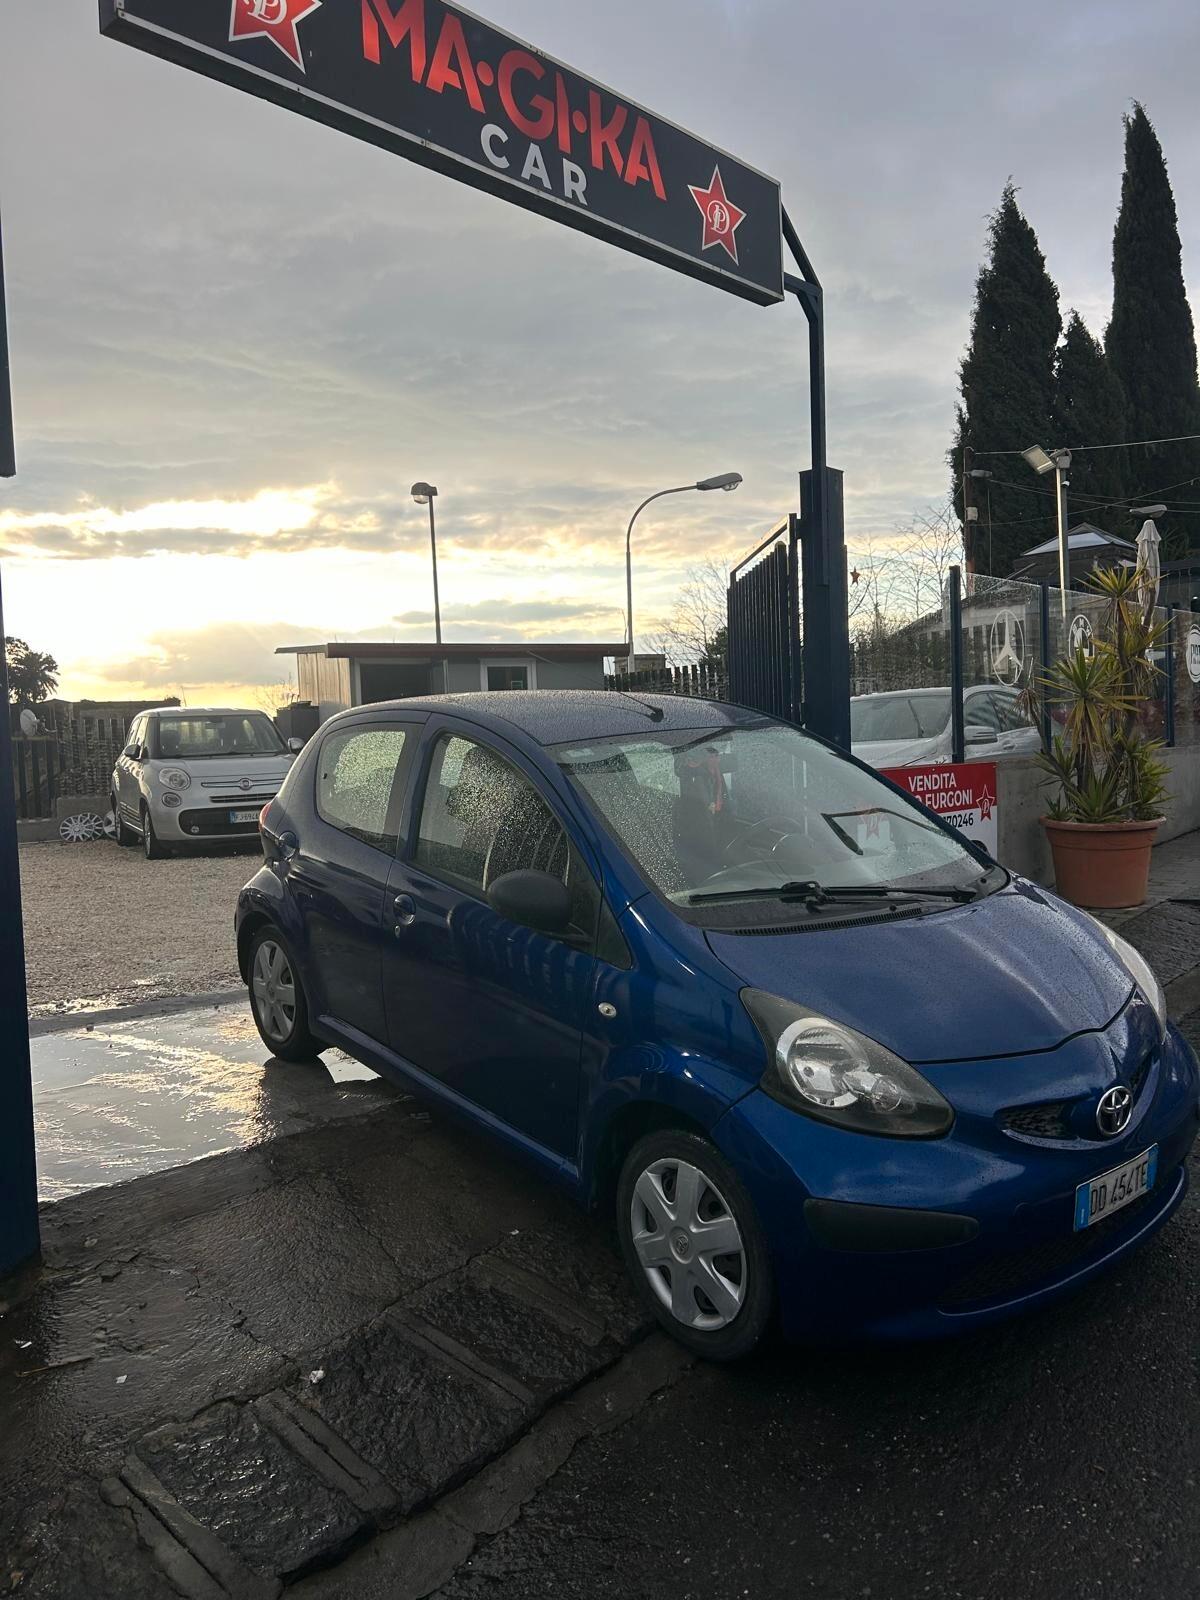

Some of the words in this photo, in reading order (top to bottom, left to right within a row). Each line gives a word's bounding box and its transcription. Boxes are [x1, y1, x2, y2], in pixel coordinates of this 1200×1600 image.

[480, 123, 588, 206] CAR
[908, 772, 957, 793] VENDITA
[926, 789, 973, 809] FURGONI
